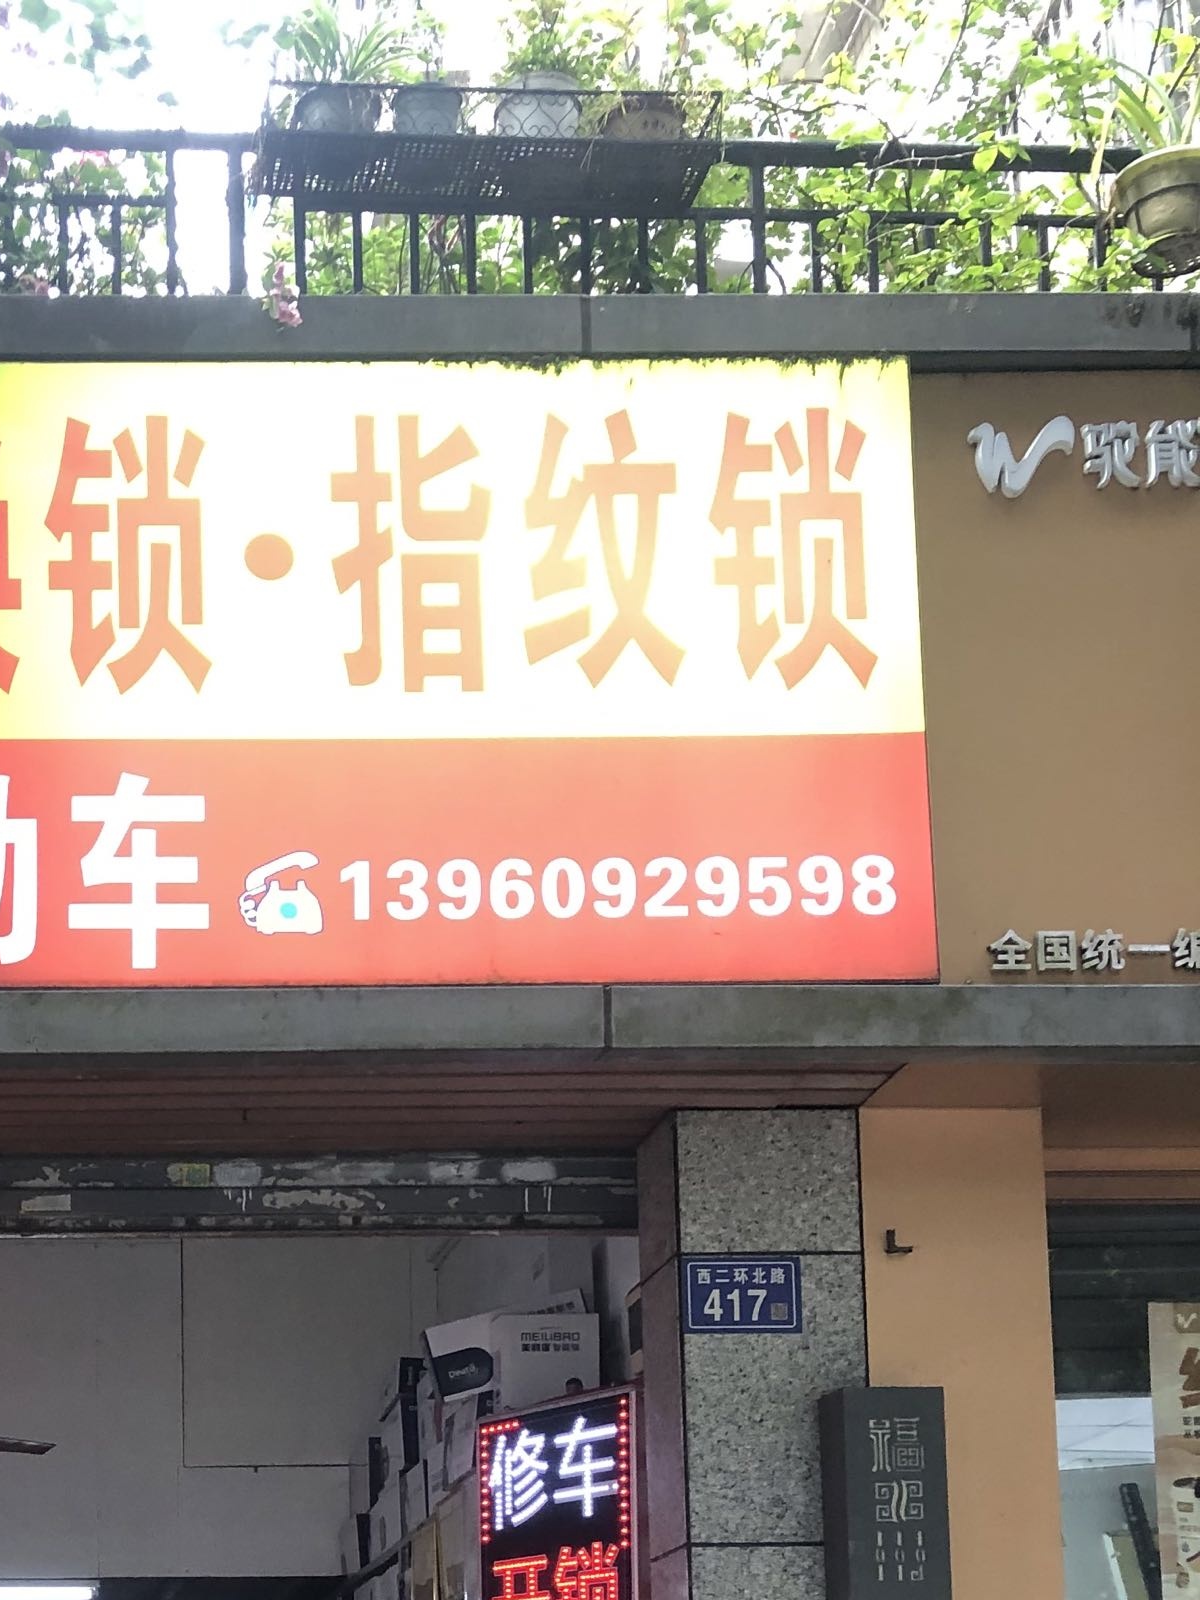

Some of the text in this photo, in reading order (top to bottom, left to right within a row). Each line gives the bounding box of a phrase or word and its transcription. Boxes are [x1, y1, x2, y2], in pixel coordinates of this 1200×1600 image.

[339, 855, 898, 924] 13960929598
[696, 1267, 785, 1285] 西二环北路
[703, 1288, 767, 1321] 417
[489, 1415, 620, 1531] 修车
